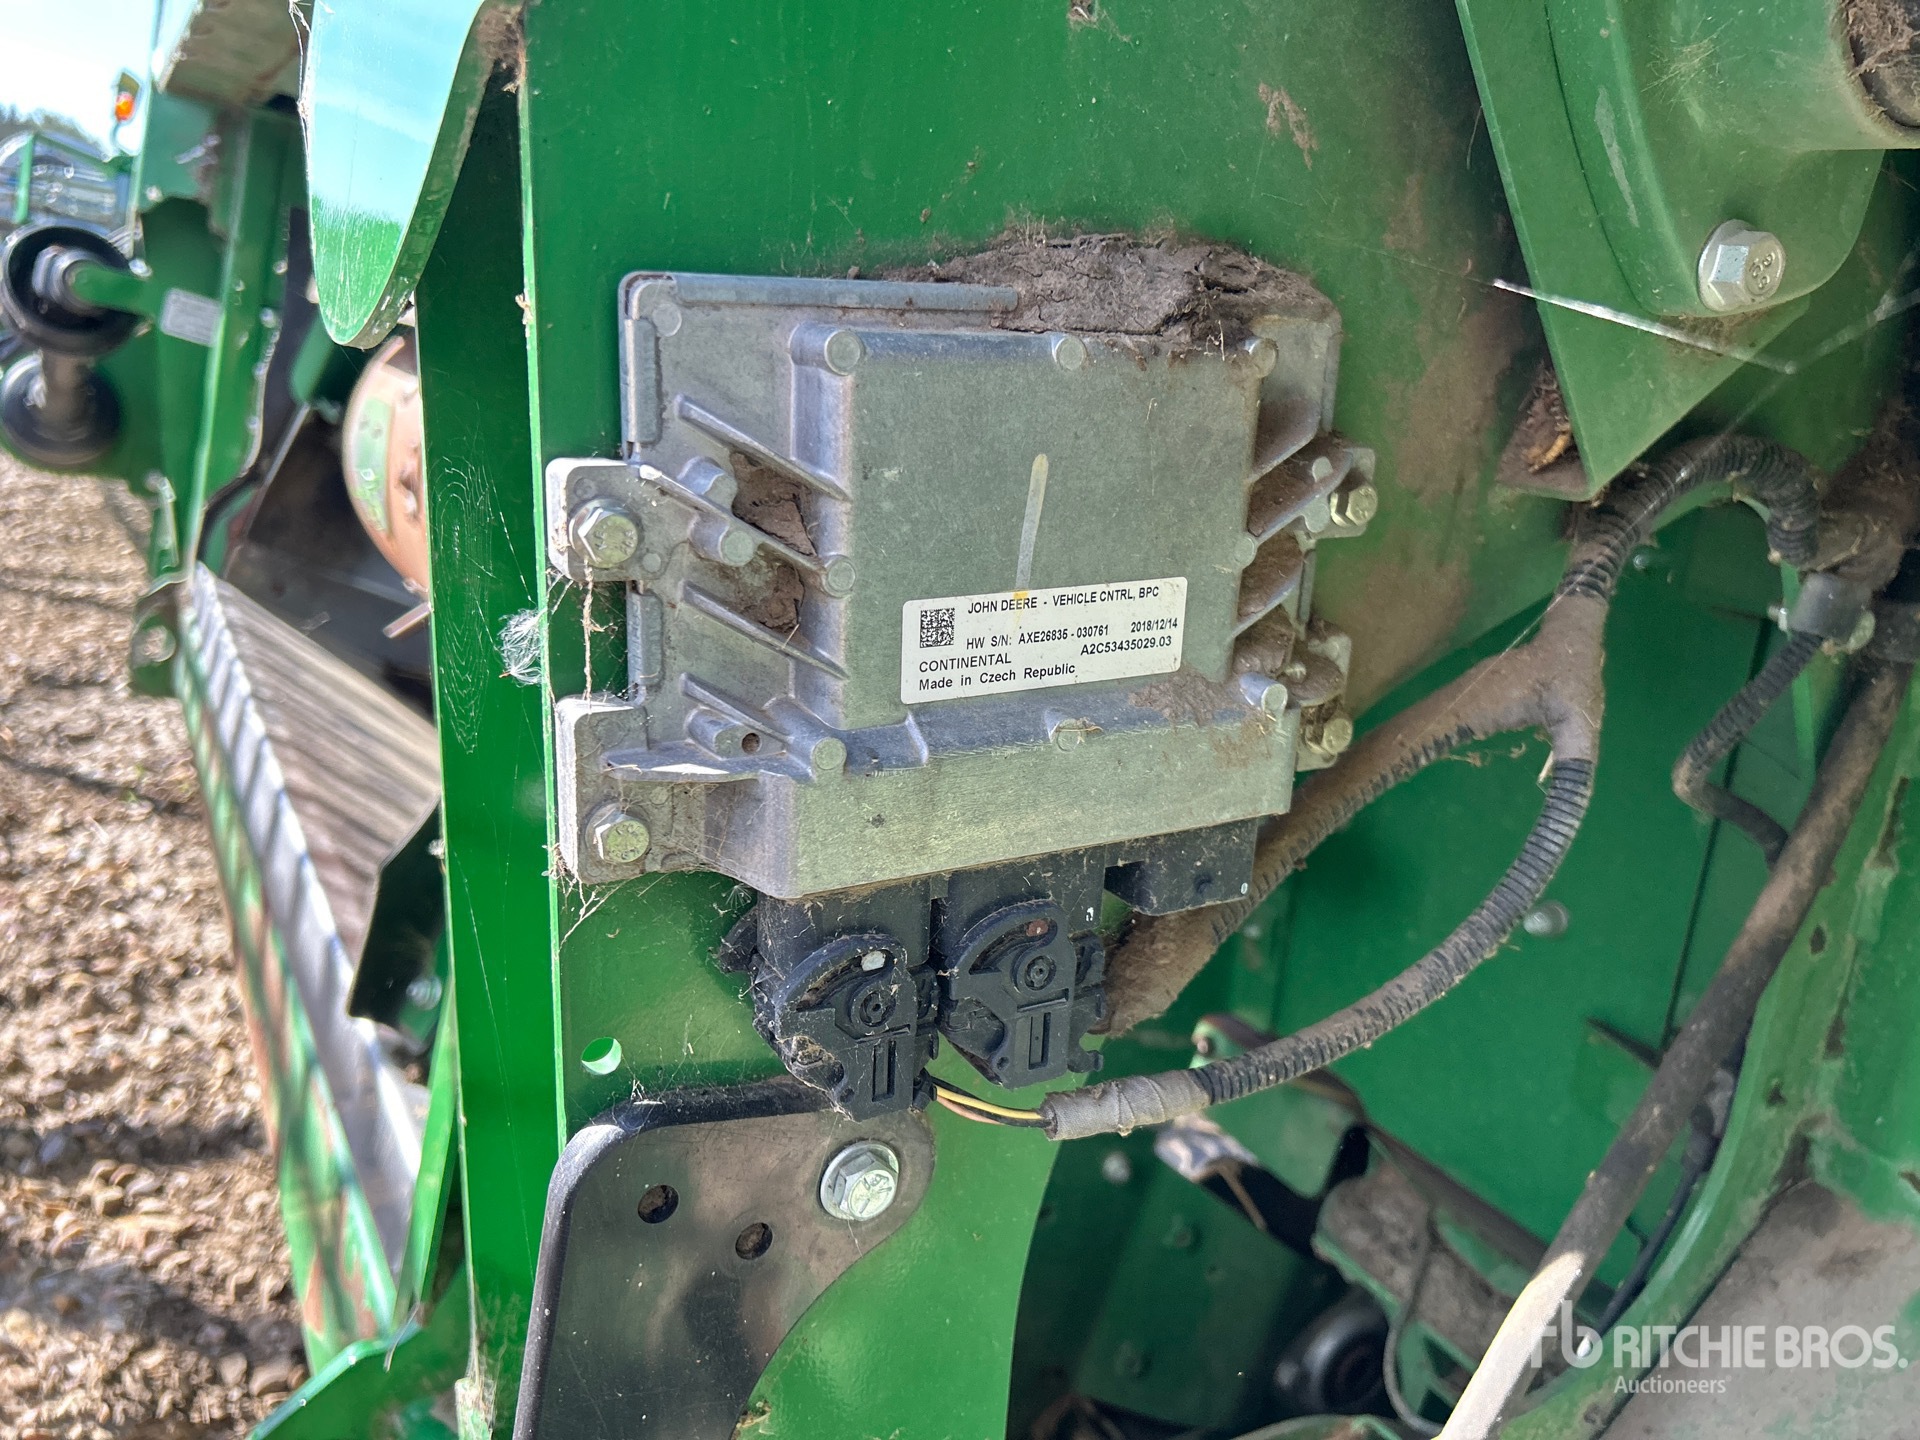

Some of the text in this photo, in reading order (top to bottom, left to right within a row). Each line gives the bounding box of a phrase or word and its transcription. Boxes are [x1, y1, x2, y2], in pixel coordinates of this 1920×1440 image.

[967, 601, 998, 614] JOHN
[1001, 597, 1037, 611] DEERE
[1053, 593, 1097, 606] VEHICLE
[1099, 589, 1135, 602] CNTRL,
[1139, 586, 1159, 598] BPC
[1131, 618, 1178, 633] 2018/12/14
[966, 637, 984, 650] HW
[991, 635, 1012, 647] S/N:
[1076, 625, 1109, 639] 030761
[1081, 636, 1172, 656] A2C53435029.03
[919, 653, 1011, 673] CONTINENTAL
[919, 664, 1076, 691] Made in Czech Republic
